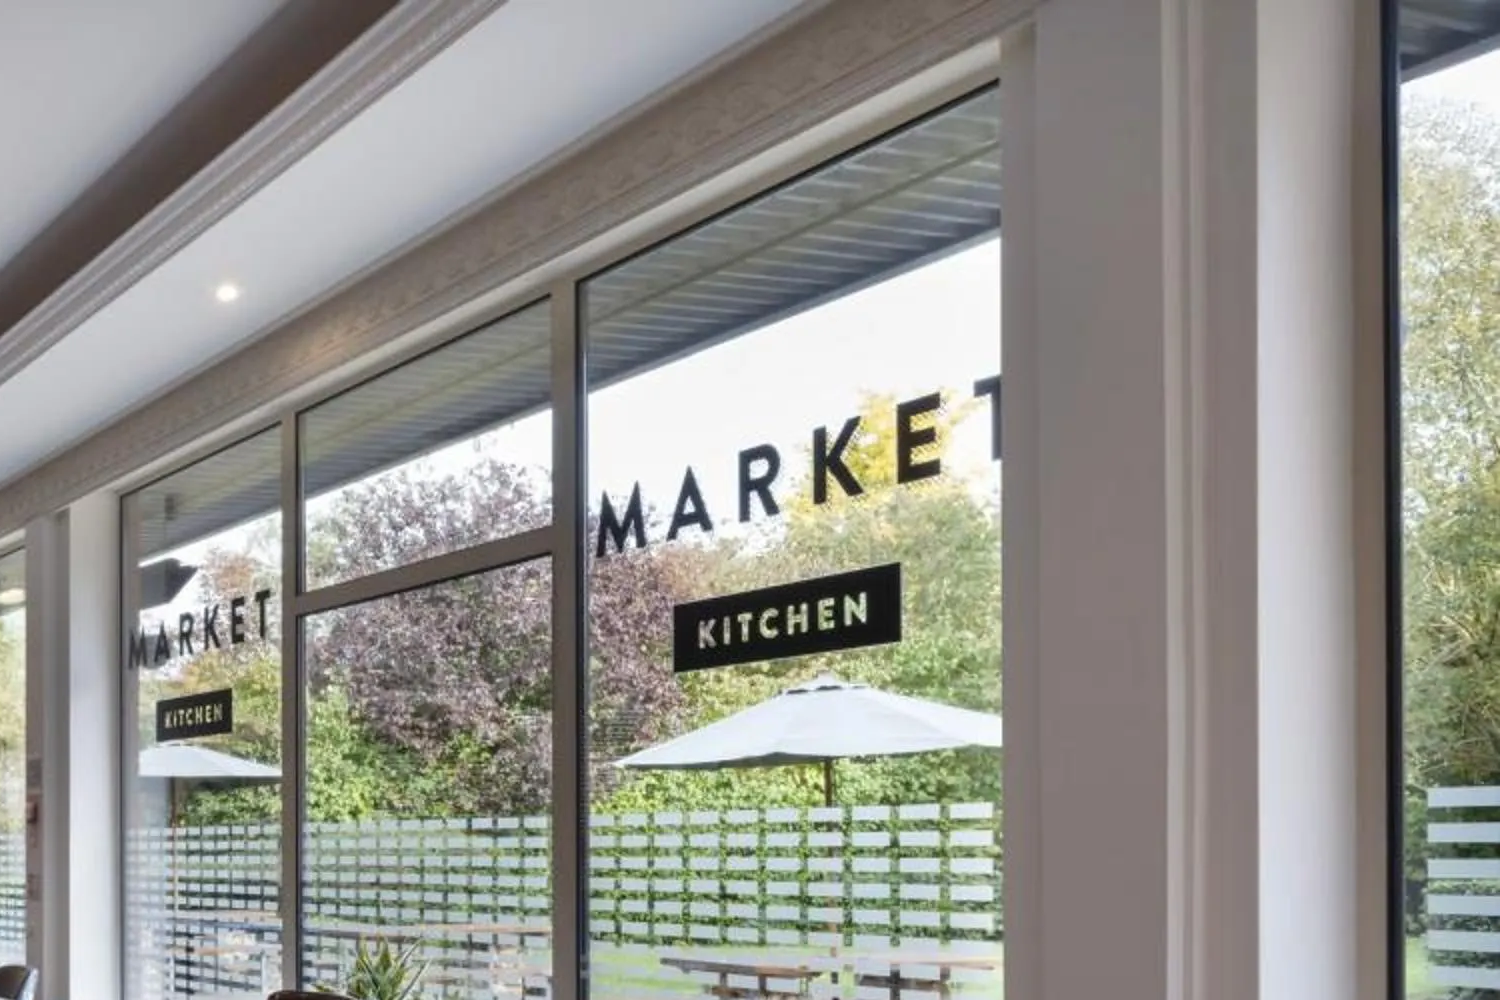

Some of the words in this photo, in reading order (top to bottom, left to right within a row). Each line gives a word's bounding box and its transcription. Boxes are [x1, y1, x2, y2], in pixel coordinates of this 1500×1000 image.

[128, 590, 270, 671] MARKET
[698, 592, 868, 649] KITCHEN
[164, 703, 223, 729] KITCHEN
